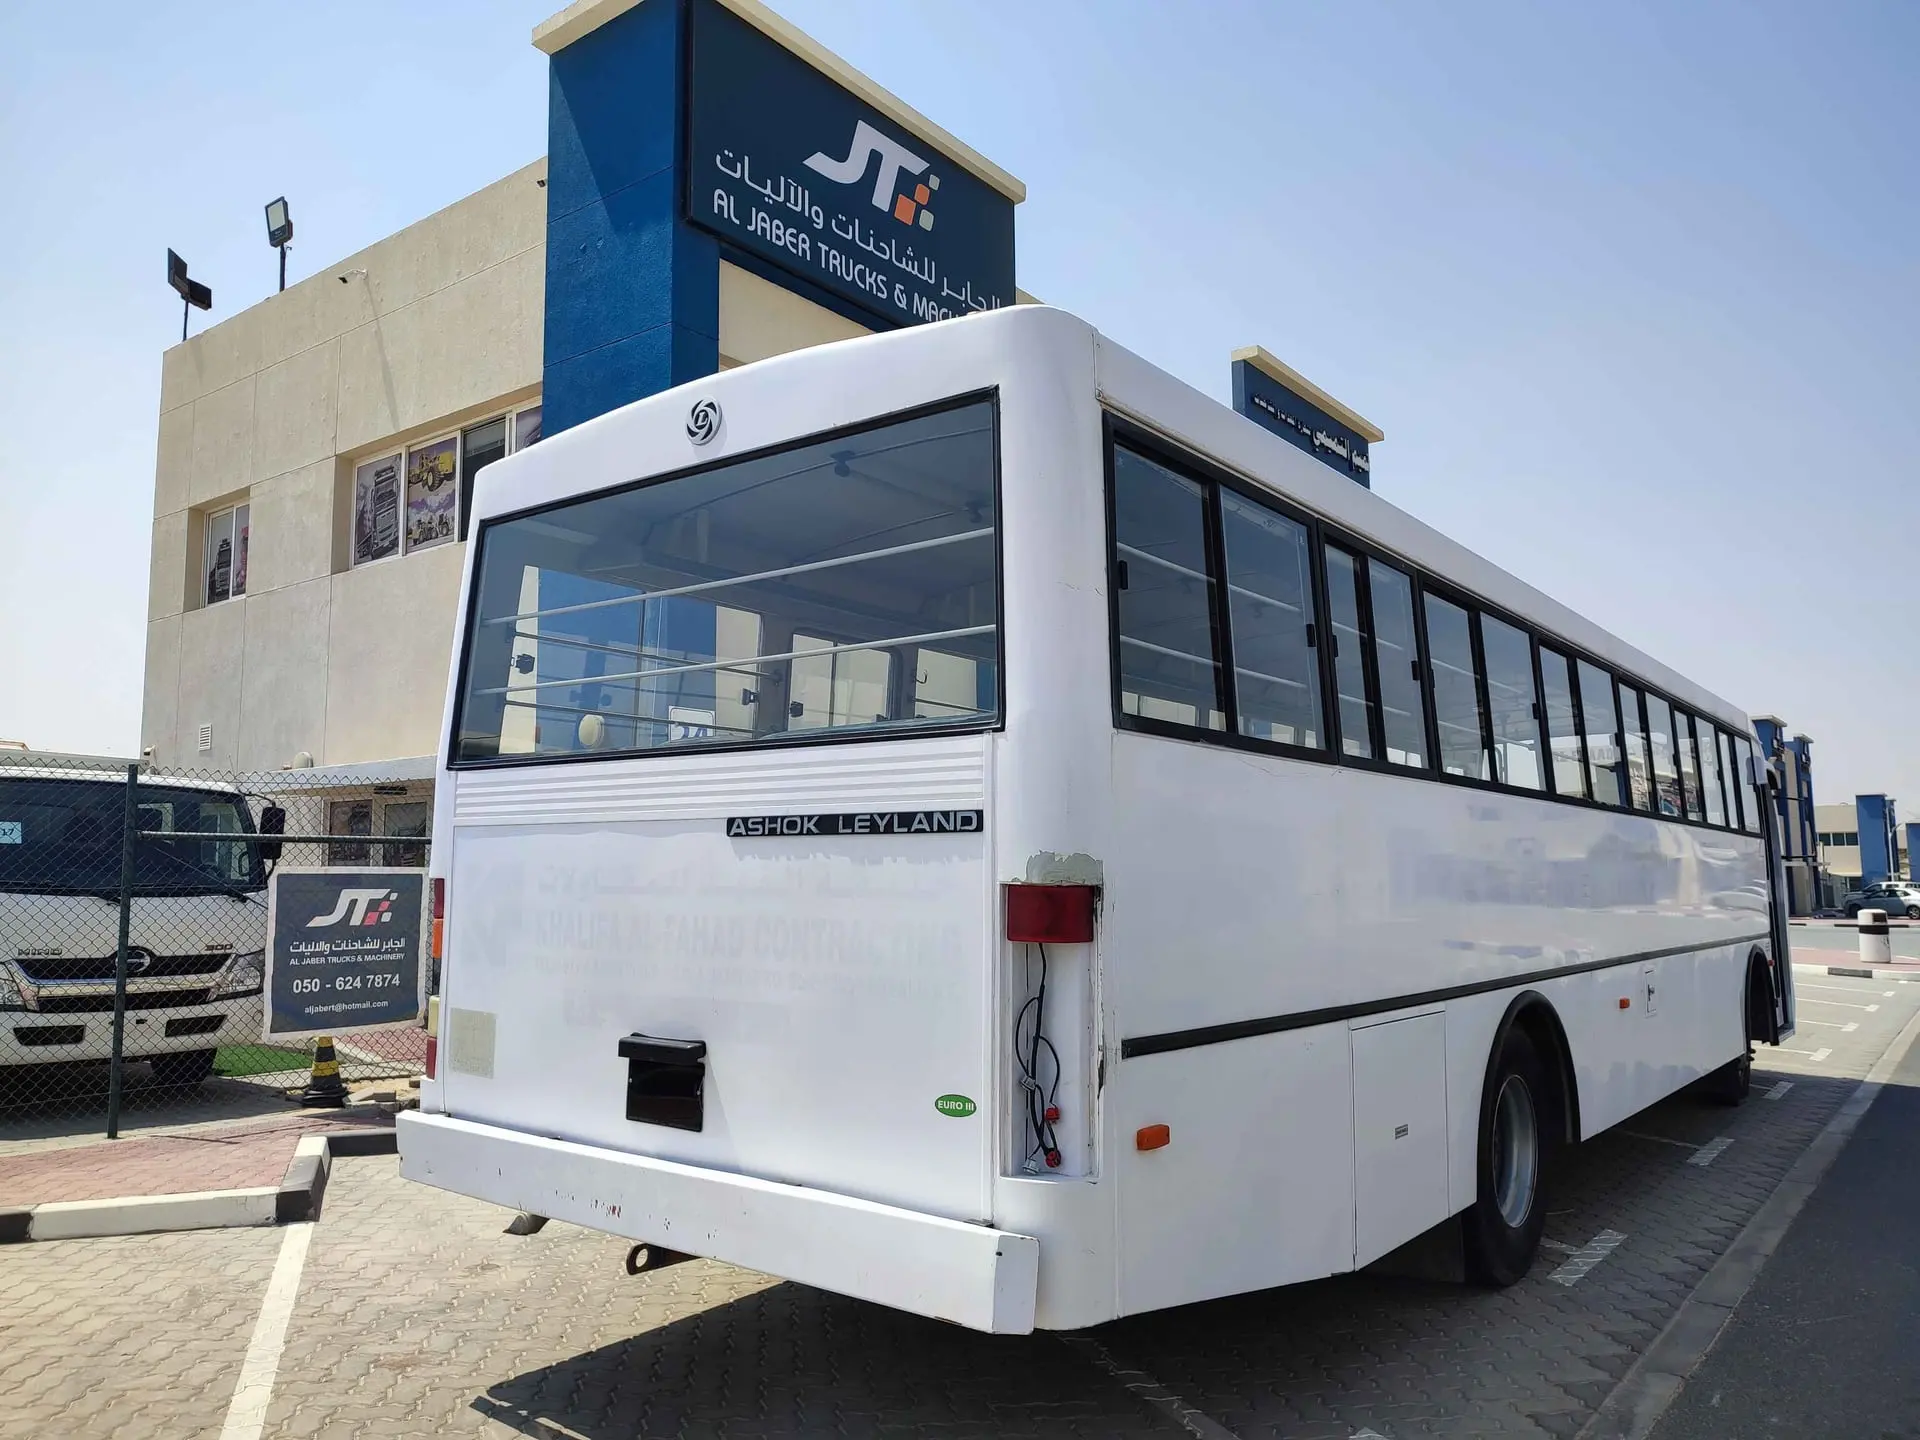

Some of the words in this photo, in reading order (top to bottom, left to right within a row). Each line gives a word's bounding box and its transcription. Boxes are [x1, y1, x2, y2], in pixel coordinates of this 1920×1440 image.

[713, 188, 740, 224] AL
[747, 206, 811, 261] JABER
[817, 241, 887, 299] TRUCKS
[893, 282, 908, 310] &
[831, 213, 936, 284] للشاحنات
[729, 815, 820, 836] ASHOK
[838, 810, 978, 833] LEYLAND
[332, 936, 380, 951] للشاحنات
[381, 937, 405, 952] الجابر
[289, 958, 300, 966] AL
[301, 957, 326, 965] JABER
[327, 955, 355, 964] TRUCKS
[356, 954, 363, 962] &
[364, 953, 405, 961] MACHINERY
[292, 978, 320, 993] 050
[335, 976, 361, 990] 624
[366, 973, 400, 988] 7874
[304, 1000, 388, 1015] aljabert@hotmail.com
[937, 1100, 963, 1110] EURO
[965, 1102, 974, 1111] III
